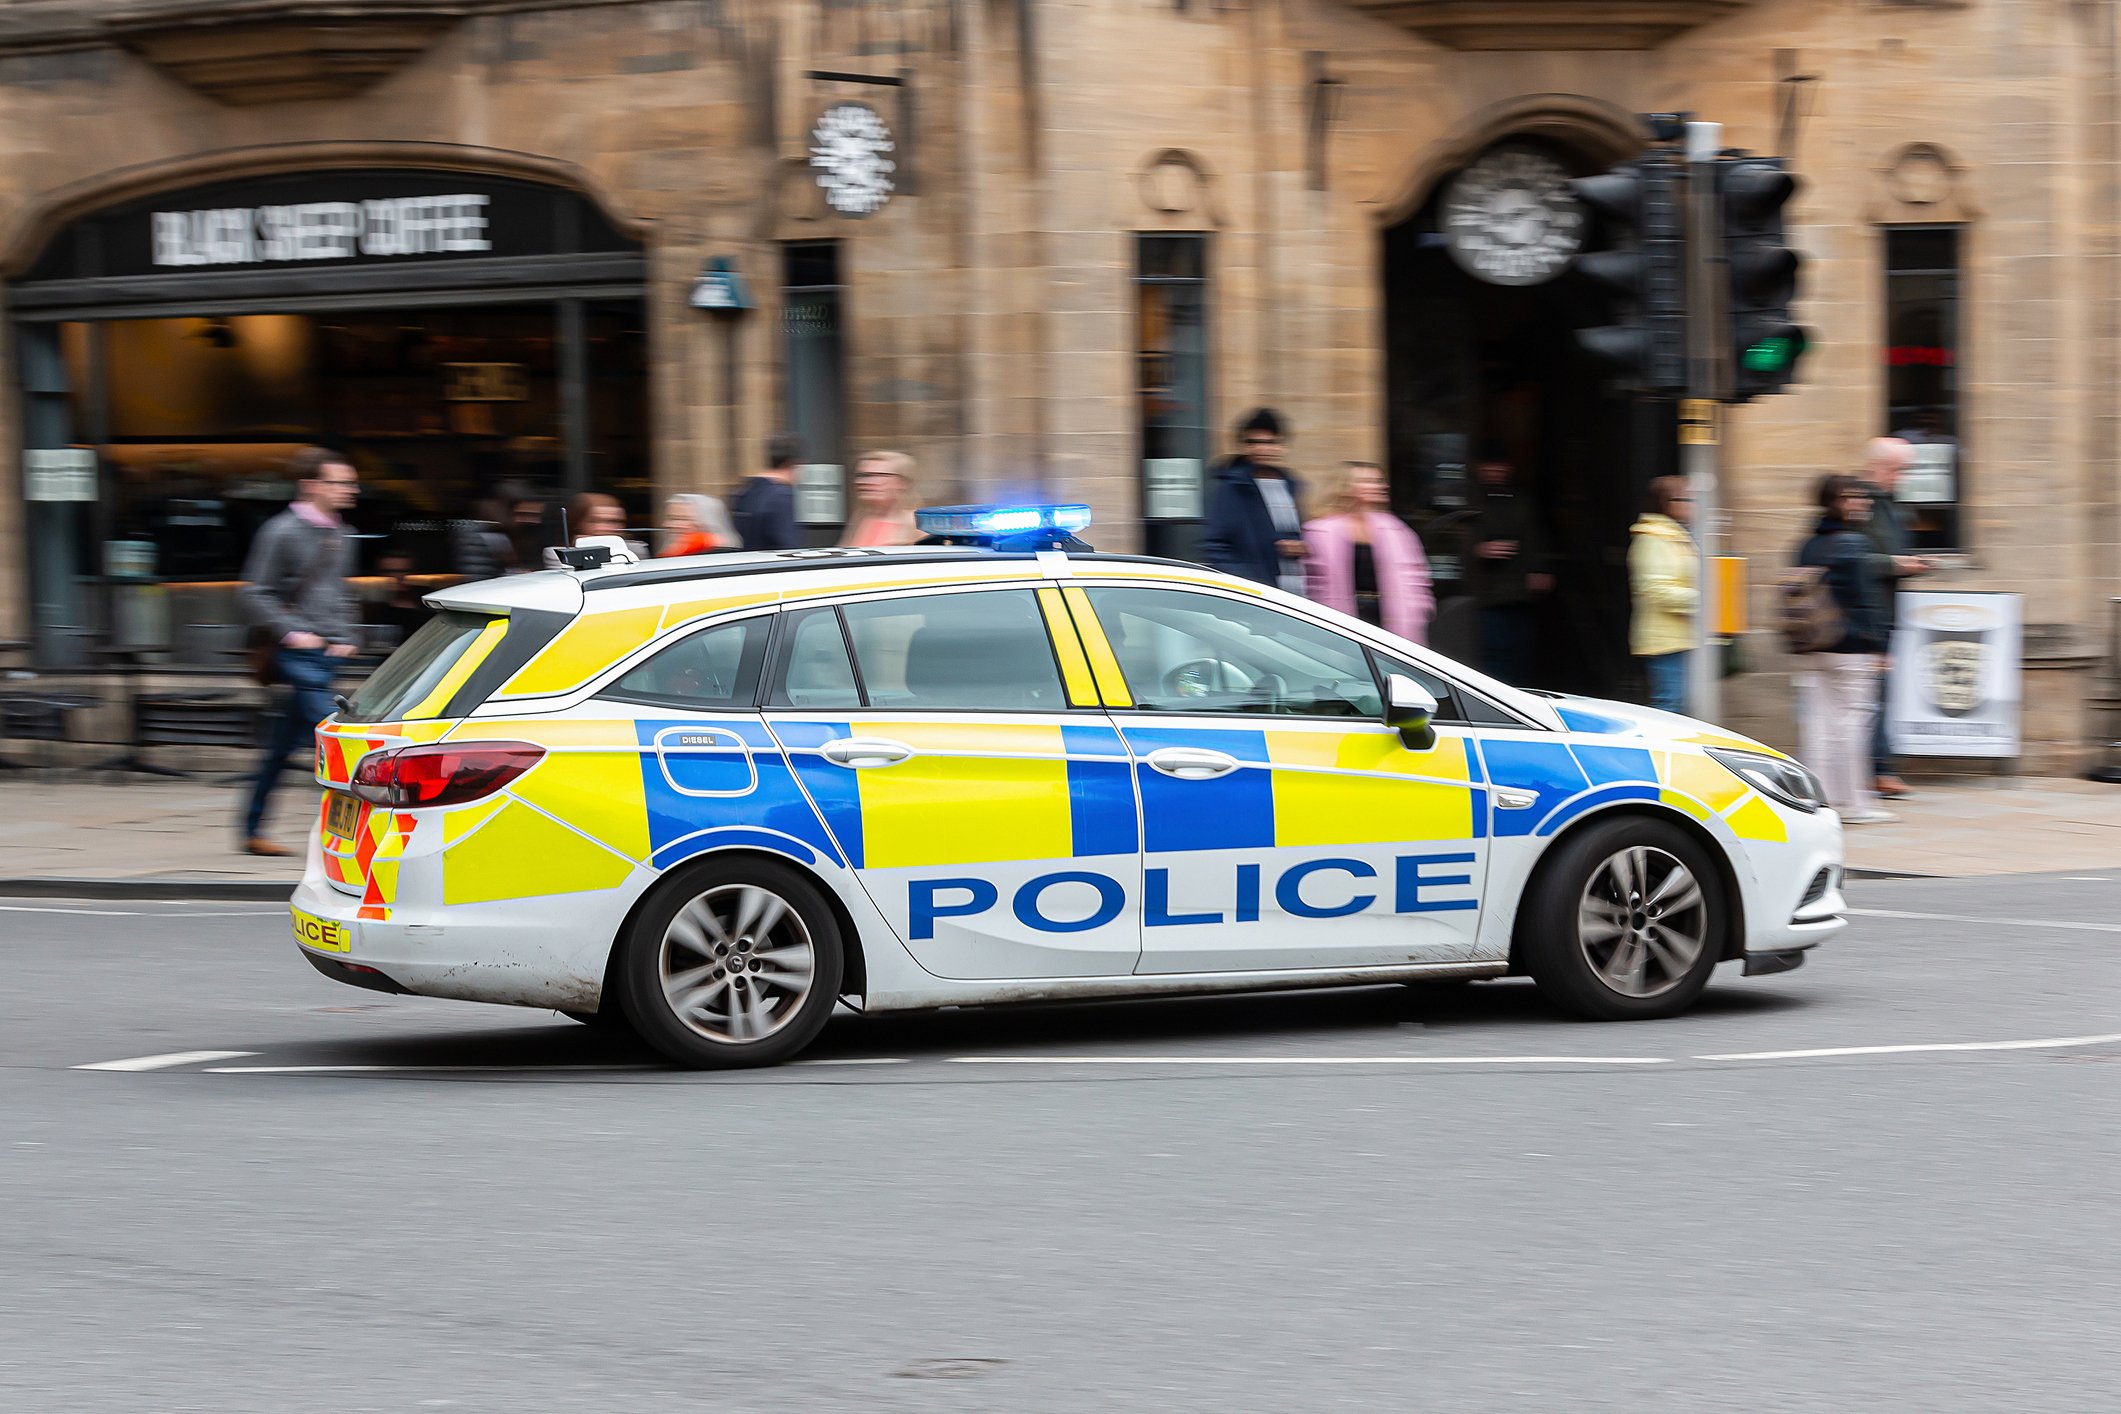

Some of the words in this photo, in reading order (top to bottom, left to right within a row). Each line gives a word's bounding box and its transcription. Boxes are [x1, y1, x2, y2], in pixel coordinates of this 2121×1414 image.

[680, 735, 715, 745] DIESEL
[908, 852, 1478, 941] POLICE
[291, 911, 339, 946] LICE
